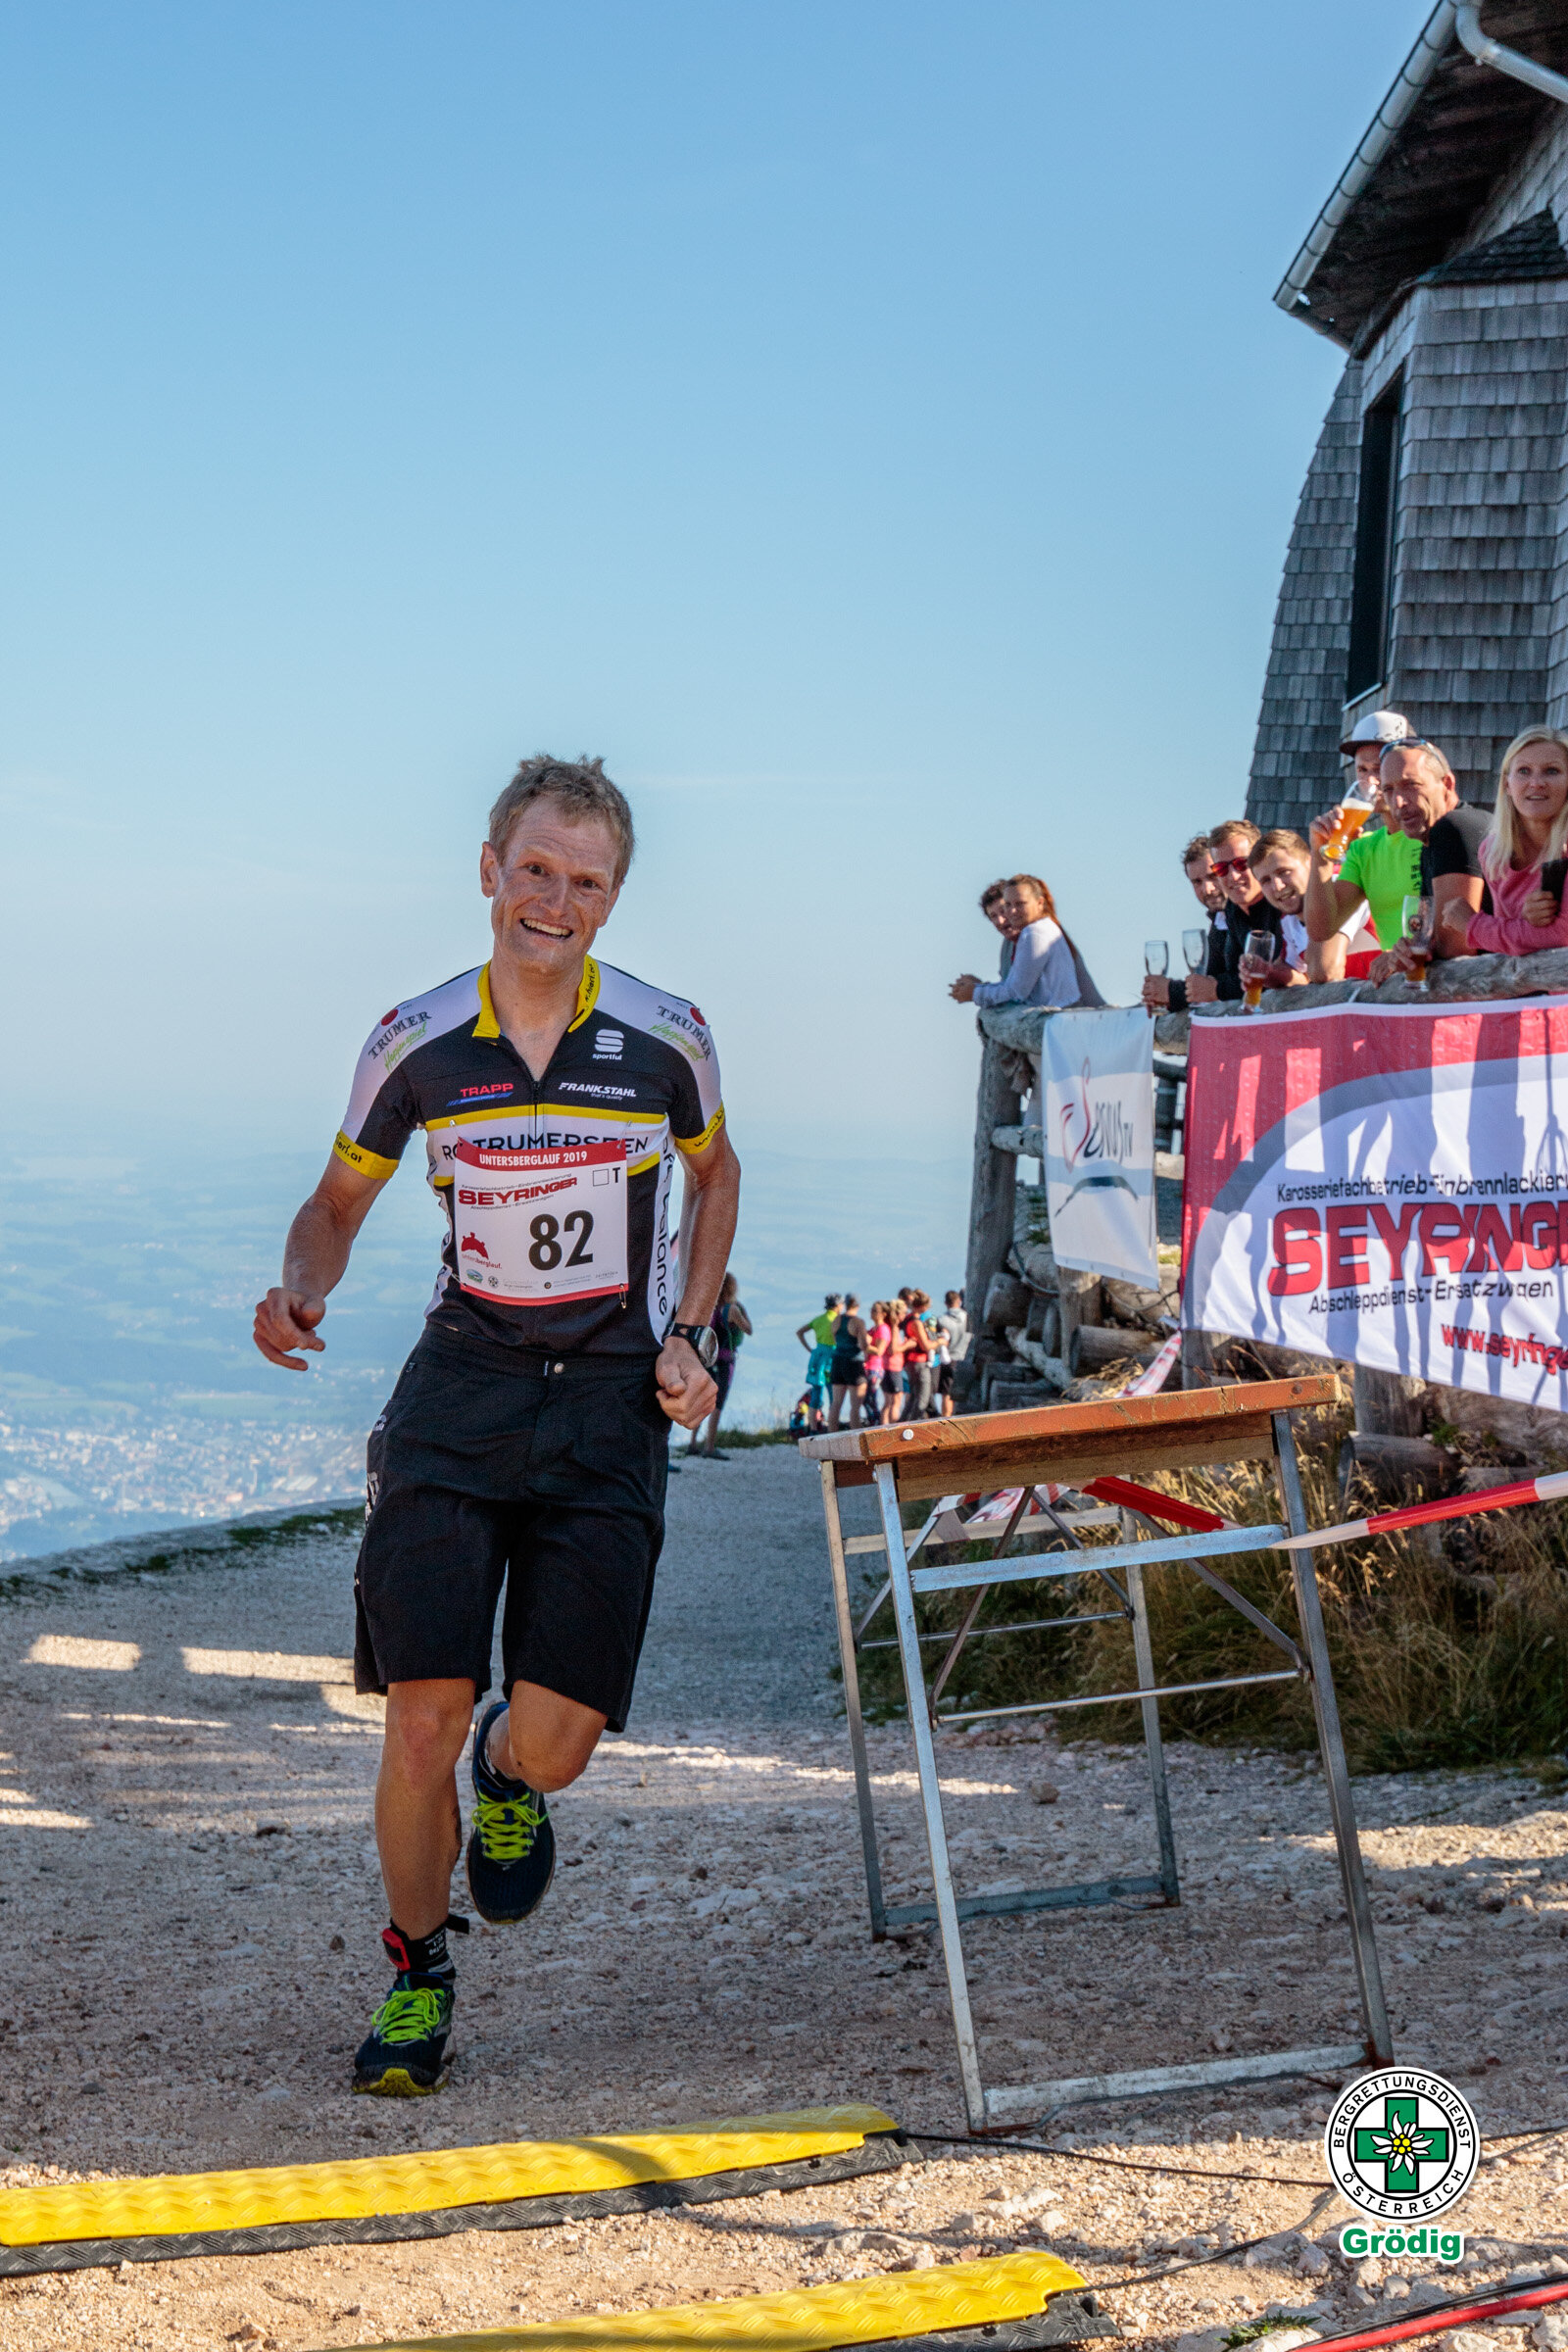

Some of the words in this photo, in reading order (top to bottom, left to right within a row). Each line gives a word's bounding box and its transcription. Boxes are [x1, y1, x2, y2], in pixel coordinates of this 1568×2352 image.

[368, 1011, 432, 1060] TRUMER
[657, 1005, 711, 1060] TRUMER
[460, 1083, 514, 1098] TRAPP
[479, 1152, 561, 1167] UNTERSBERGLAUF
[563, 1151, 588, 1164] 2019
[612, 1167, 621, 1184] T
[458, 1176, 578, 1205] SEYRINGER
[528, 1209, 595, 1271] 82
[1267, 1200, 1568, 1297] SEYRING
